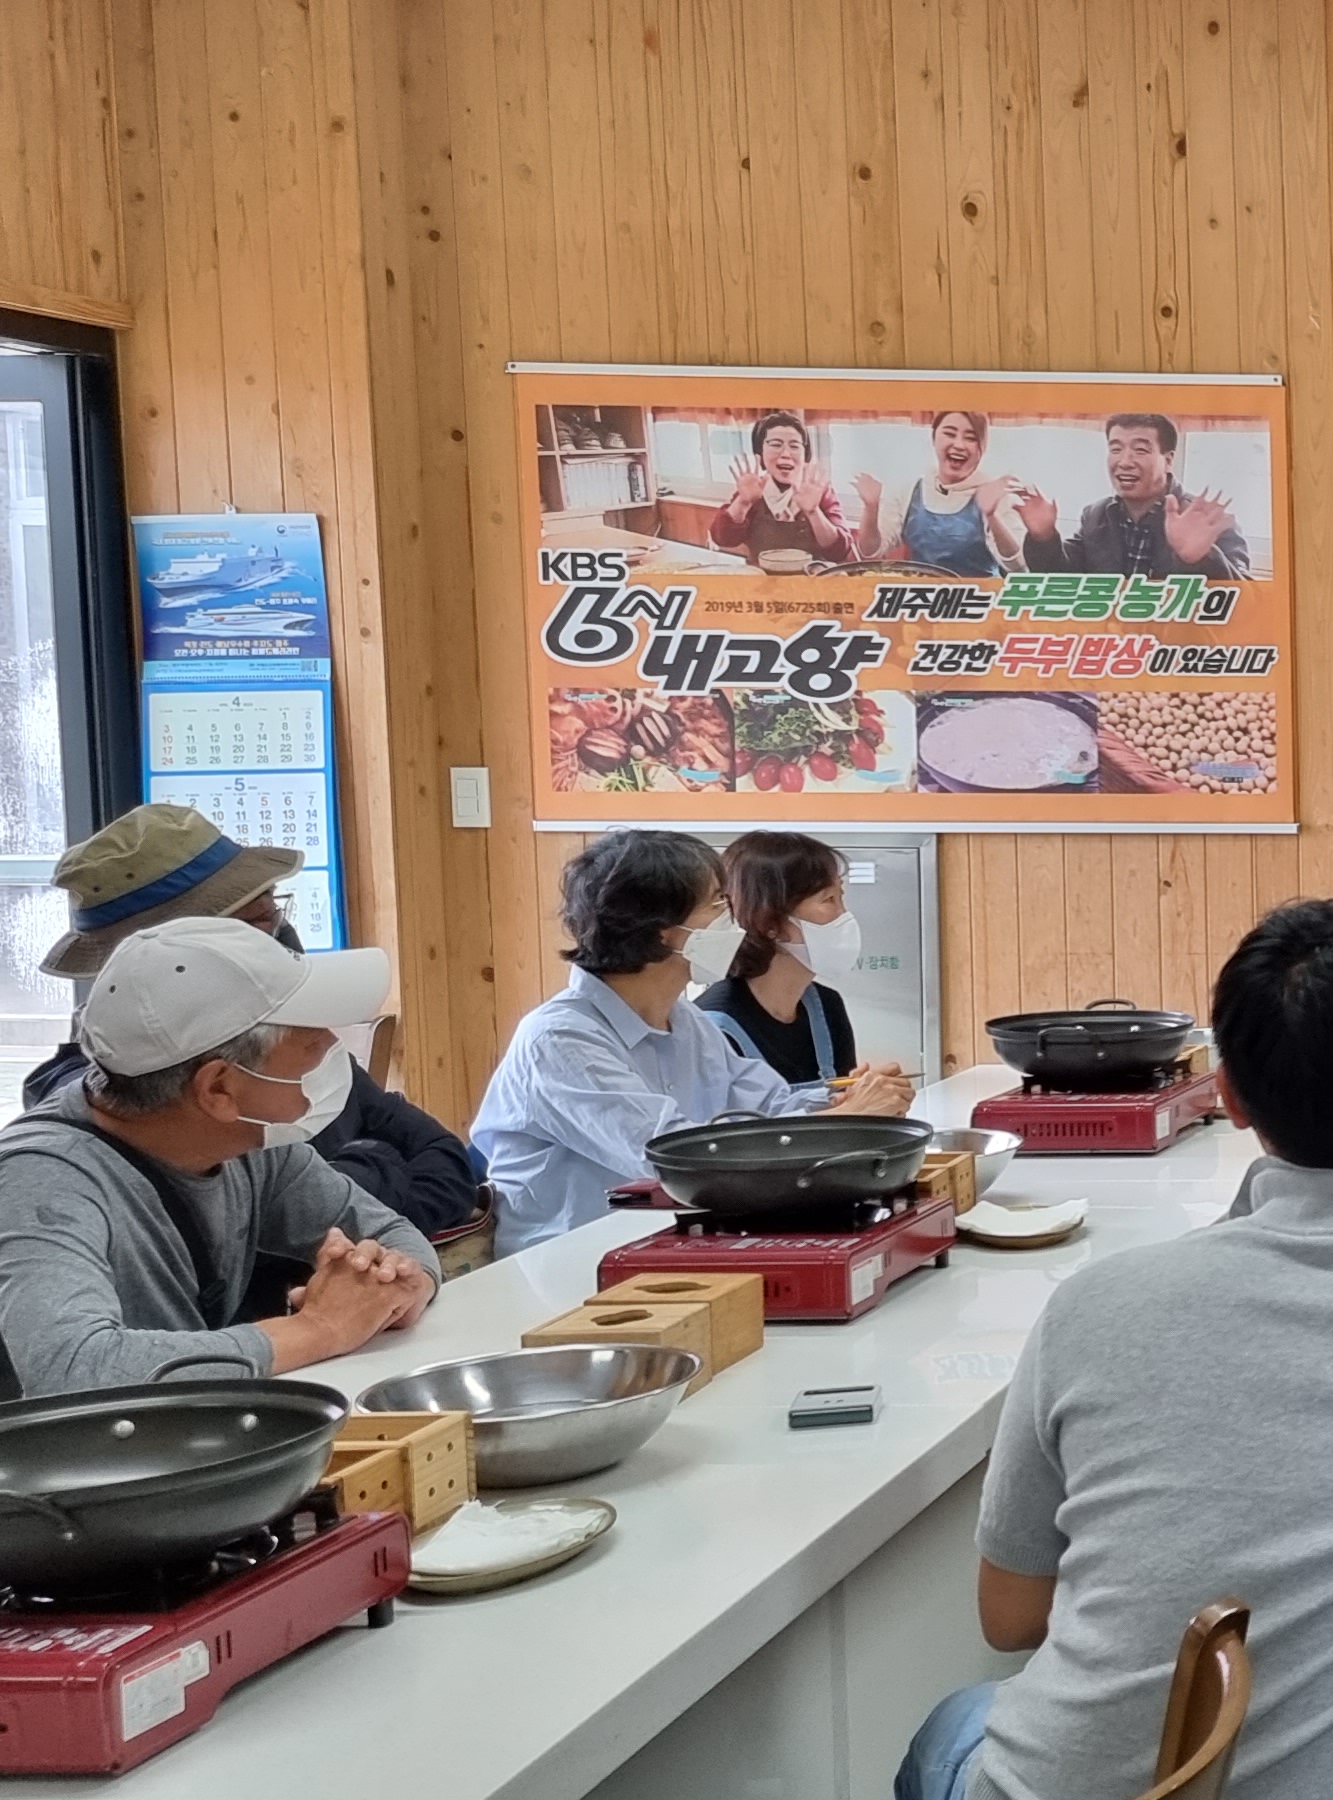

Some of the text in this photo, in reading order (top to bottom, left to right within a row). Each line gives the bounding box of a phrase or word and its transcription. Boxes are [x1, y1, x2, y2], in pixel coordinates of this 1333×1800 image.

[541, 551, 626, 582] KBS
[866, 587, 992, 619] 제주에는
[998, 574, 1119, 620] 푸른콩
[704, 601, 743, 613] 2019년
[746, 601, 763, 613] 3월
[766, 602, 830, 614] 5일(6725회)
[545, 586, 693, 662] 6시
[642, 624, 886, 698] 내고향
[911, 642, 998, 673] 건강한
[1000, 636, 1076, 676] 두부
[1175, 646, 1275, 675] 있습니다
[231, 696, 241, 707] 4
[282, 711, 312, 720] 1 2
[164, 722, 312, 733] 3 4 5 6 7 8 9
[162, 733, 314, 744] 10 11 12 13 14 15 16
[163, 743, 315, 755] 17 18 19 20 21 22 23
[161, 754, 316, 765] 24 25 26 27 28 29 30
[234, 778, 245, 791] 5
[213, 798, 221, 807] 3
[237, 797, 244, 807] 4
[261, 797, 268, 806] 5
[284, 796, 292, 805] 6
[308, 796, 315, 805] 7
[212, 809, 318, 821] 10 11 12 13 14
[236, 824, 248, 834] 18
[259, 824, 272, 833] 19
[282, 823, 296, 833] 20
[306, 823, 318, 832] 21
[236, 836, 319, 847] 25 26 27 28
